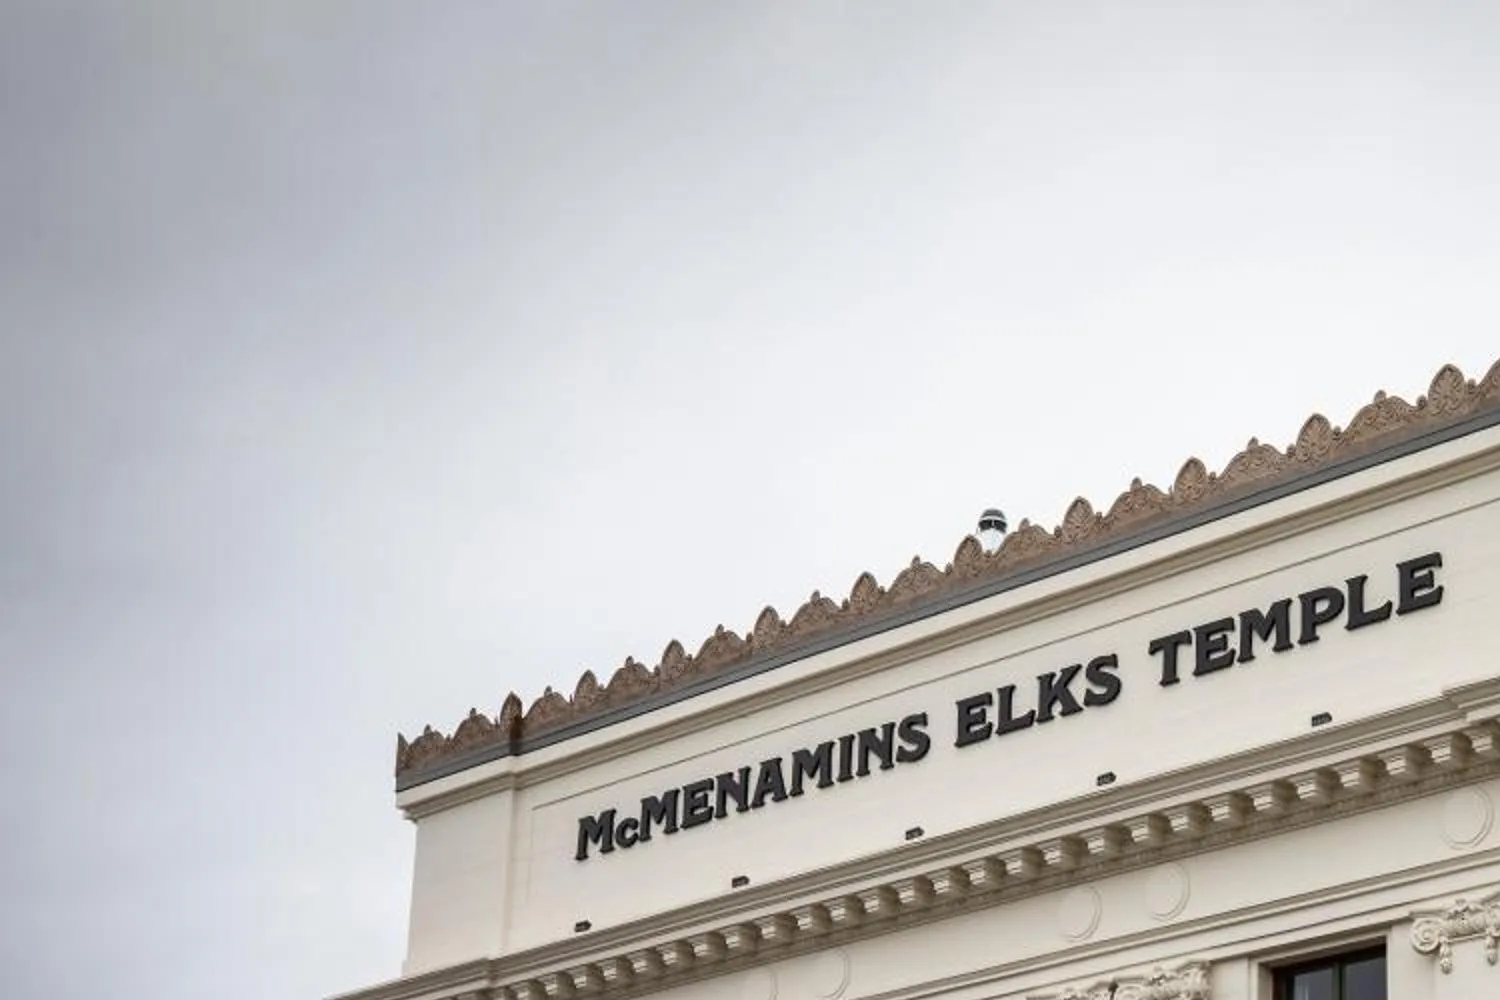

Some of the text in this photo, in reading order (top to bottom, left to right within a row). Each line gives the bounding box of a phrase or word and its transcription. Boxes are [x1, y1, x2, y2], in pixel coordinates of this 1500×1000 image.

[576, 551, 1445, 862] McMENAMINS ELKS TEMPLE
